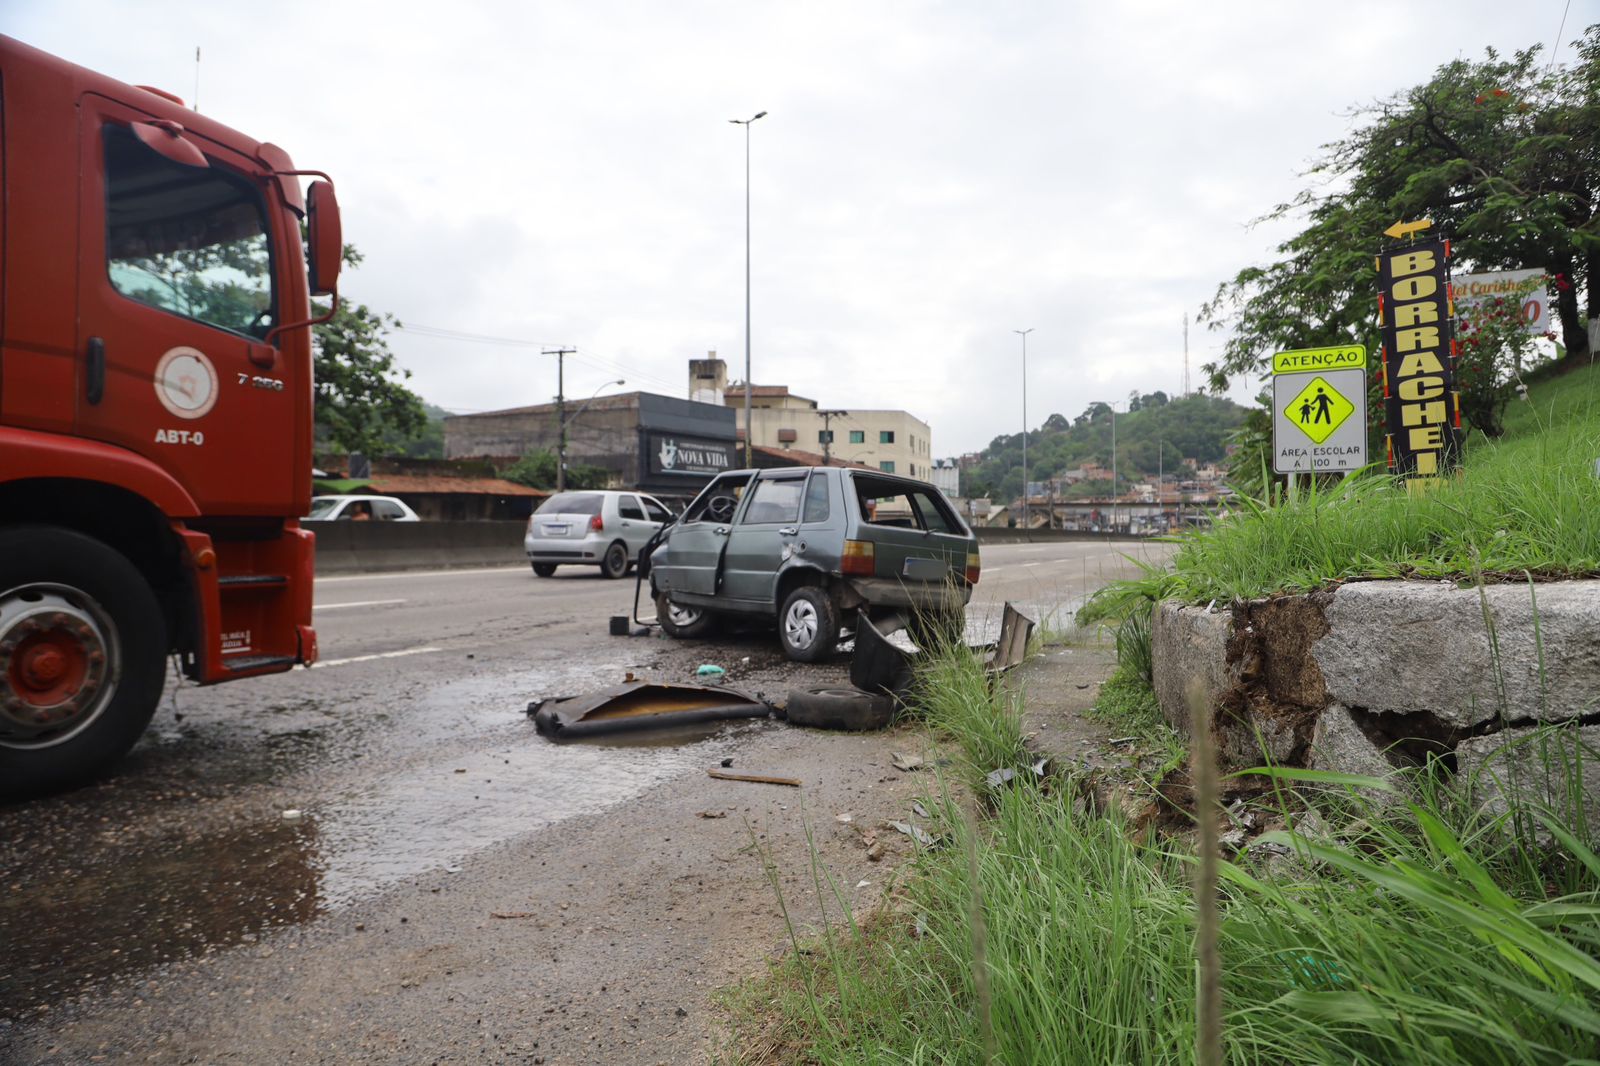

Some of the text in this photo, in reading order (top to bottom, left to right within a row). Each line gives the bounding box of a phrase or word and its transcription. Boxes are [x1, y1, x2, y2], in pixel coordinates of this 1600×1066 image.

[1280, 350, 1358, 367] ATENÇÃO
[155, 428, 204, 445] ABT-0
[677, 449, 729, 467] NOVA VIDA
[1281, 446, 1360, 457] ÁREA ESCOLAR
[1314, 459, 1330, 467] 100
